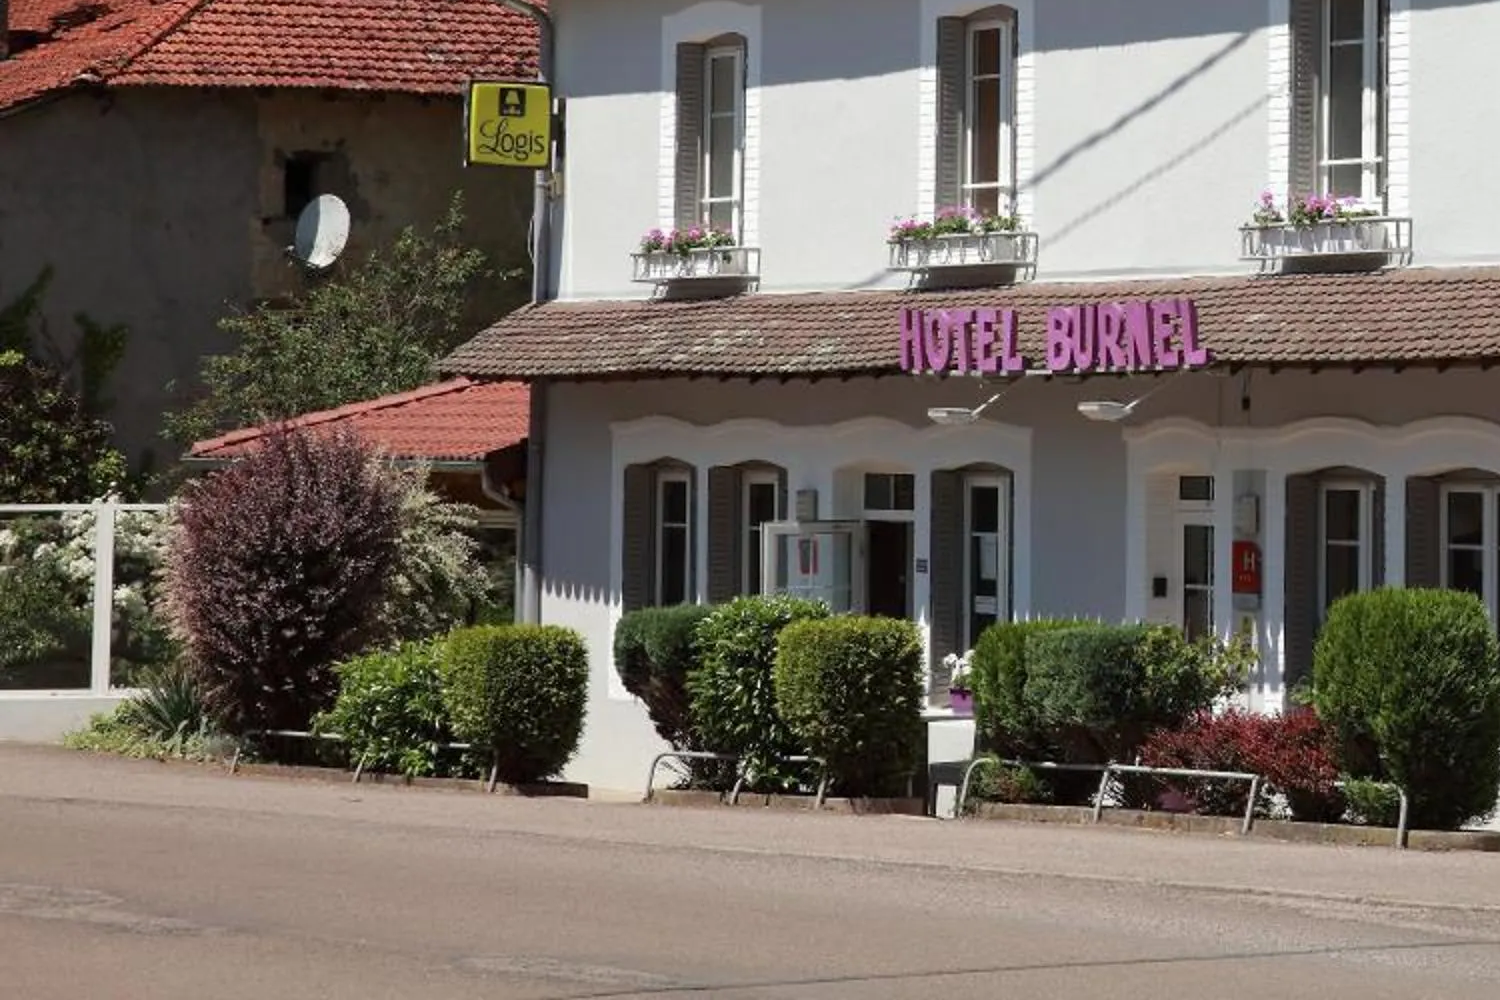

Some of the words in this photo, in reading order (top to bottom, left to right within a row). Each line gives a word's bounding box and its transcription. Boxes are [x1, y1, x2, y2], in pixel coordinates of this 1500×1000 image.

[478, 118, 545, 161] Logis
[900, 308, 1023, 372] HOTEL
[1047, 299, 1207, 371] BURNEL
[1243, 550, 1255, 572] H
